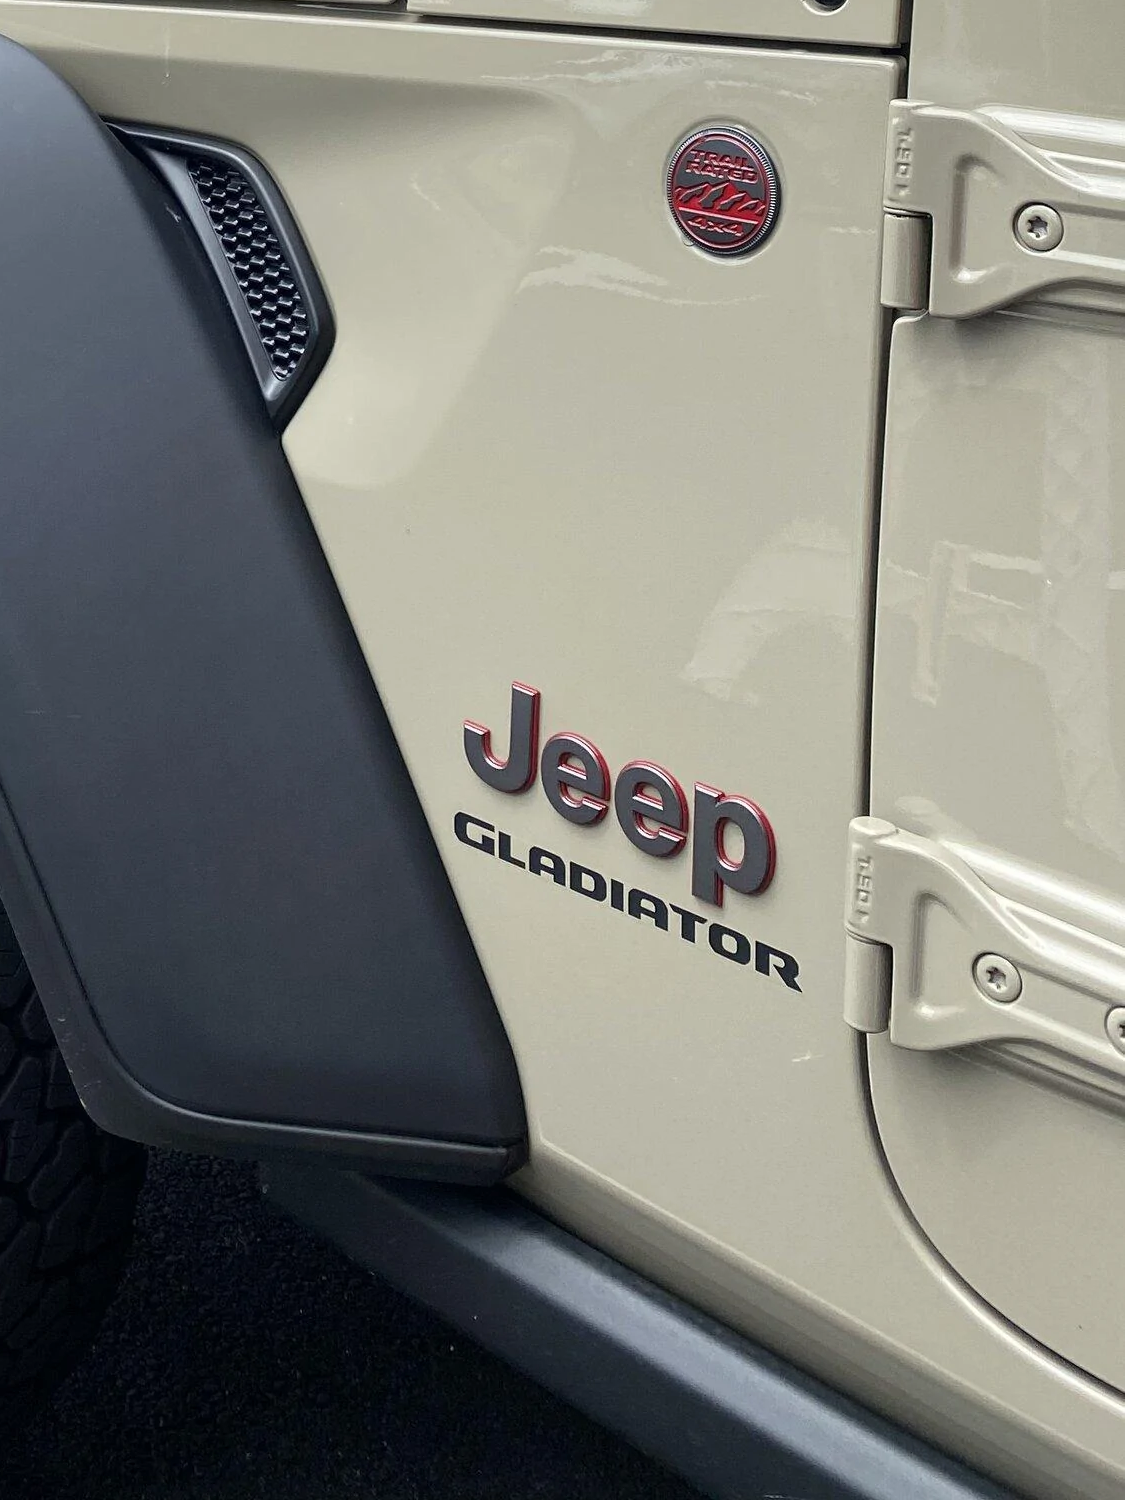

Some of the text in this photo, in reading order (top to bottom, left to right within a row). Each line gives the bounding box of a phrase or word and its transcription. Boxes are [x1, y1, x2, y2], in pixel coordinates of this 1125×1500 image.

[684, 161, 759, 184] RATED
[689, 148, 755, 172] TRAIL
[463, 680, 777, 909] Jeep
[453, 810, 803, 994] GLADIATOR
